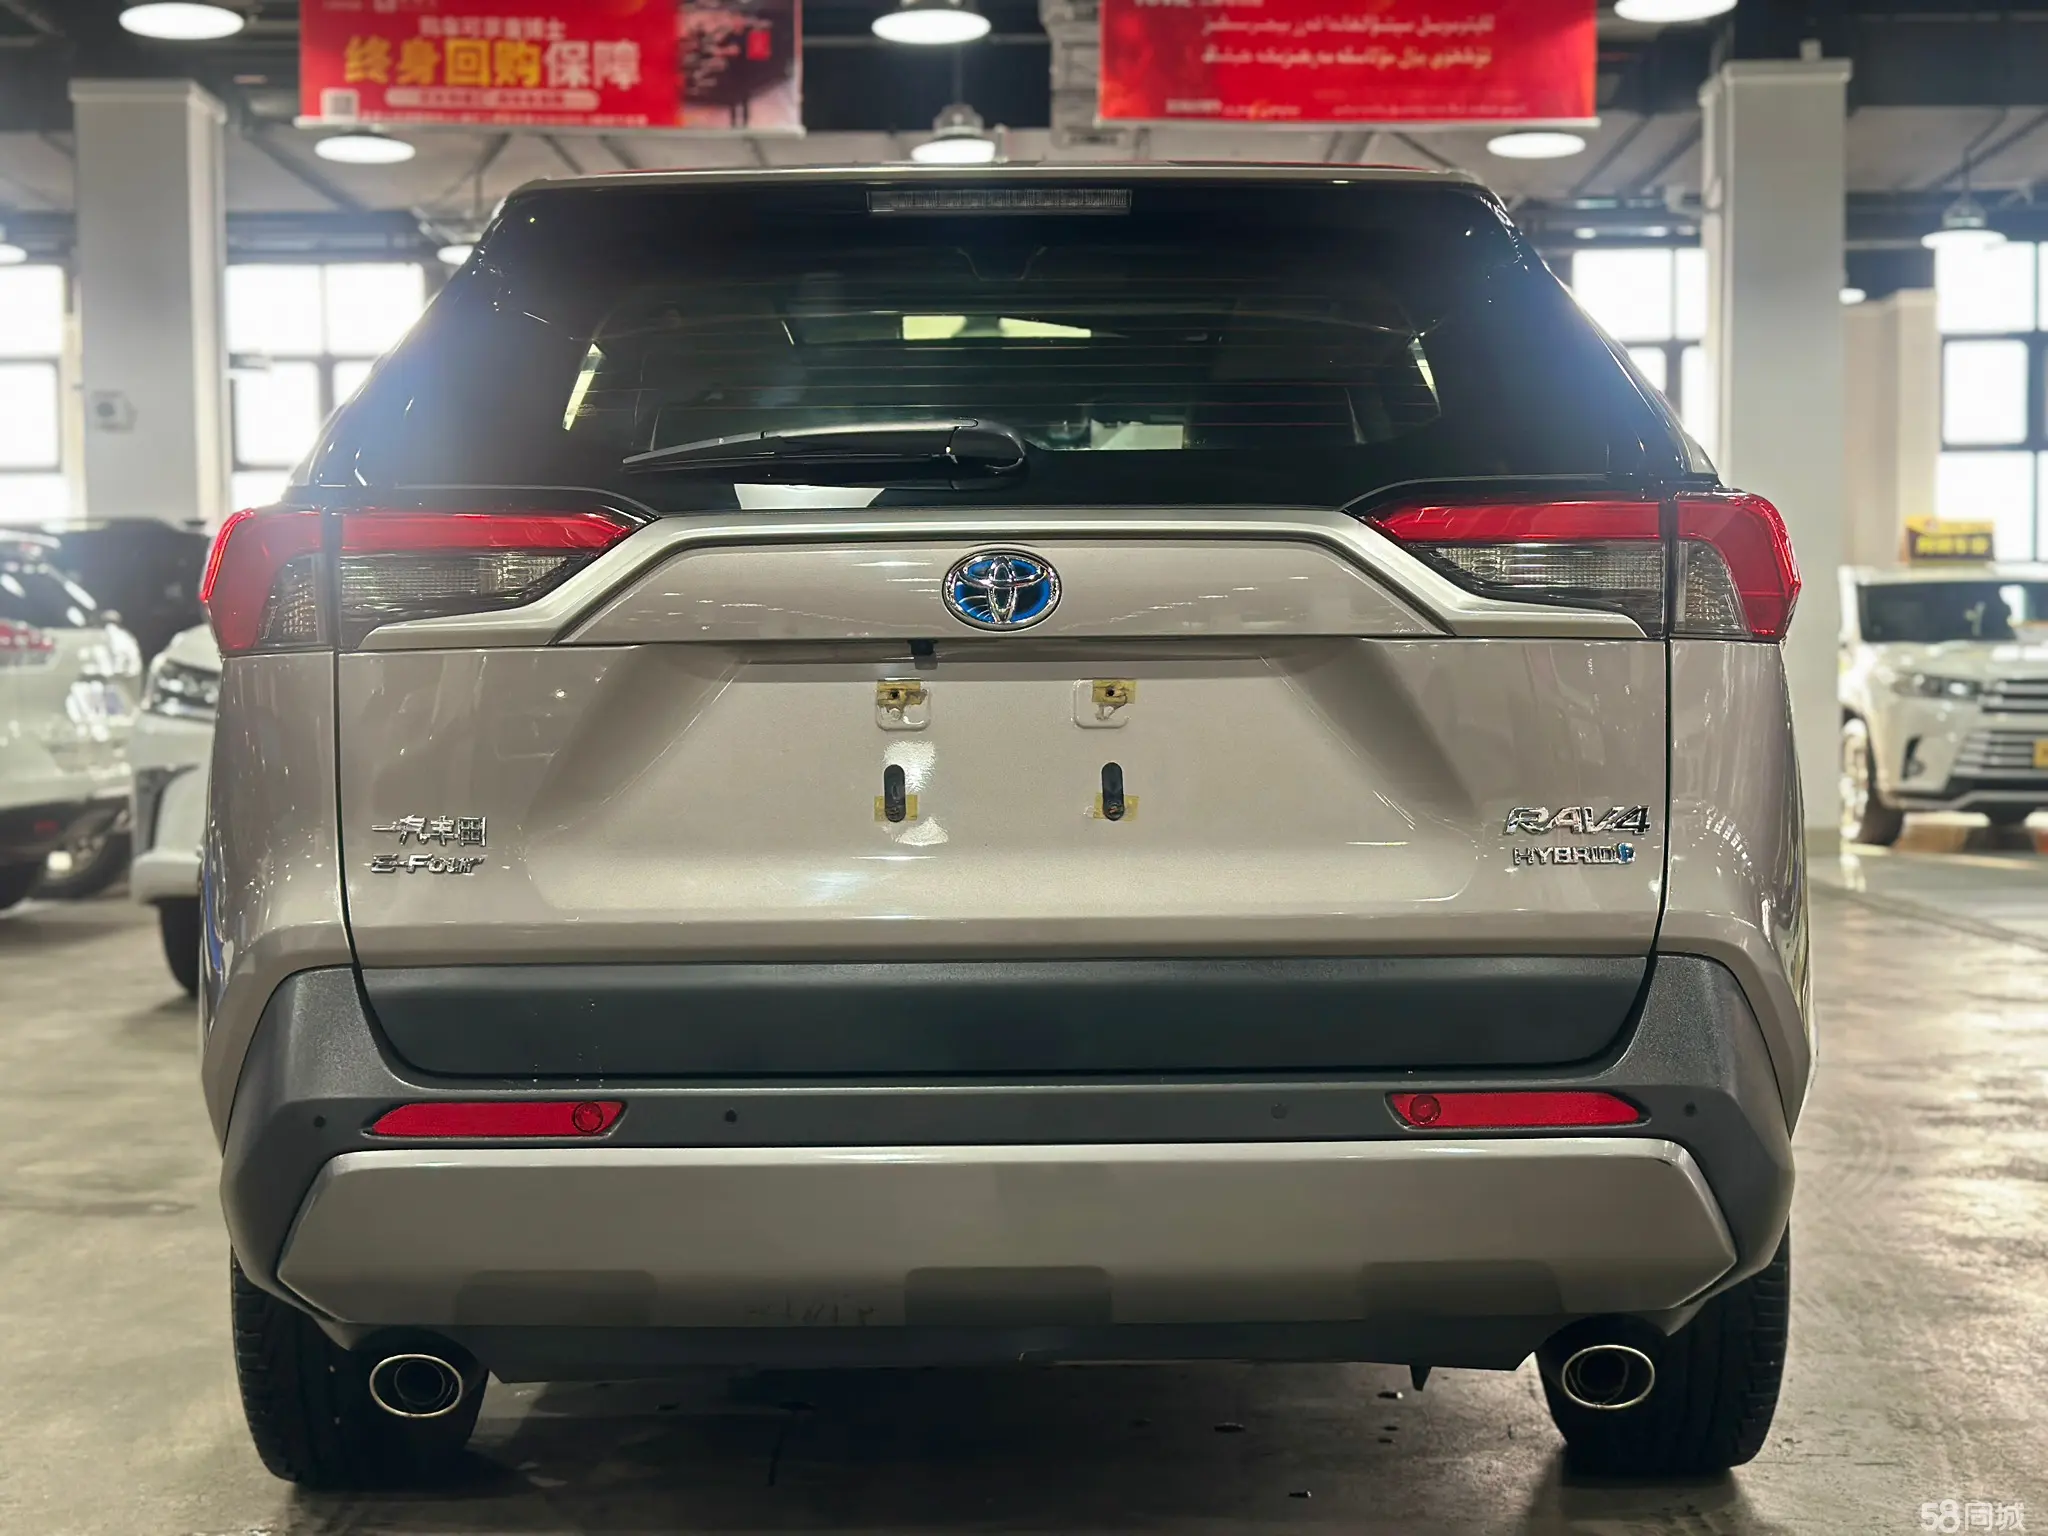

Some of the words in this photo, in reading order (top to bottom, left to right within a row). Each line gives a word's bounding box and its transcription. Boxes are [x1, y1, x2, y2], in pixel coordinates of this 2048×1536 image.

[344, 36, 642, 91] 终身回购保障
[371, 814, 487, 847] 一汽丰田
[1503, 805, 1651, 835] RAV4
[371, 852, 486, 874] E-Four
[1513, 846, 1619, 866] HYBRID
